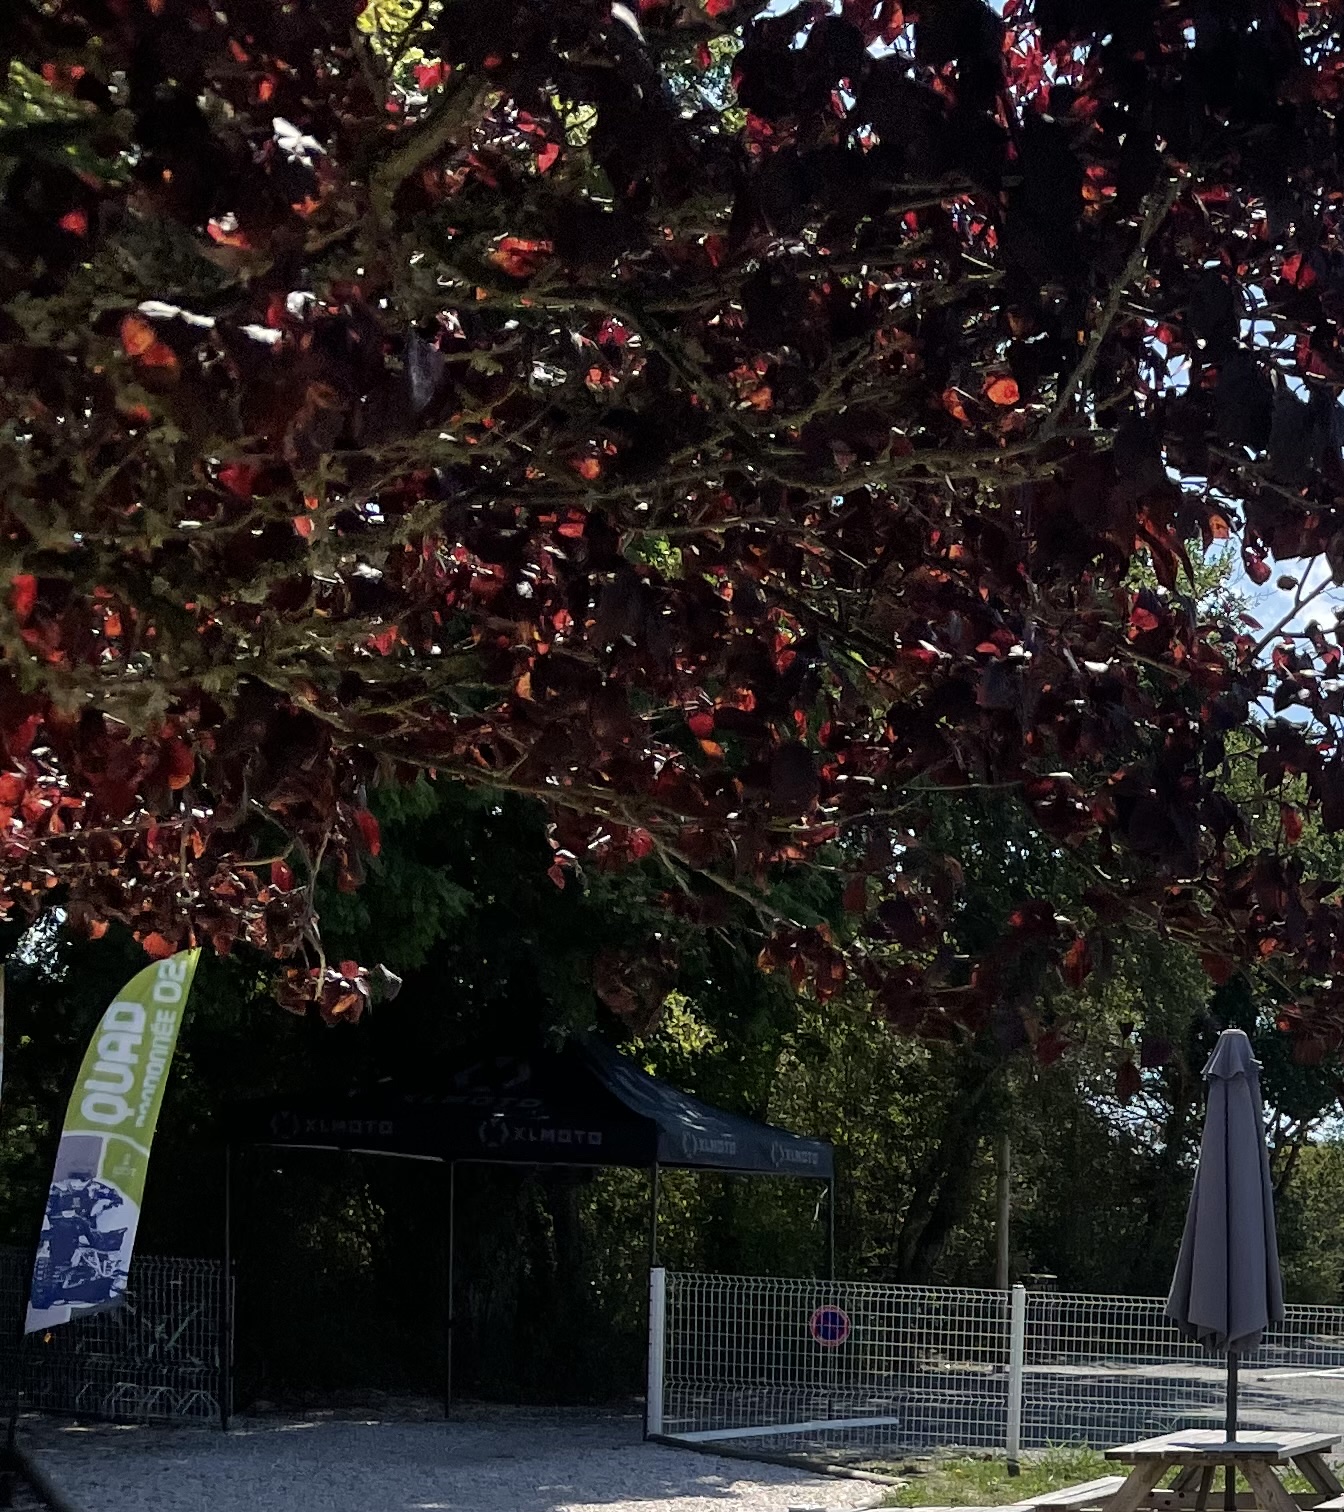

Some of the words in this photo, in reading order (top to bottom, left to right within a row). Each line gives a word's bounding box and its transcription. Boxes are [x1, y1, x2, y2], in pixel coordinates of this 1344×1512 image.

[81, 1001, 147, 1126] QUAD
[305, 1119, 393, 1136] XLMOTO
[513, 1127, 602, 1145] XLMOTO
